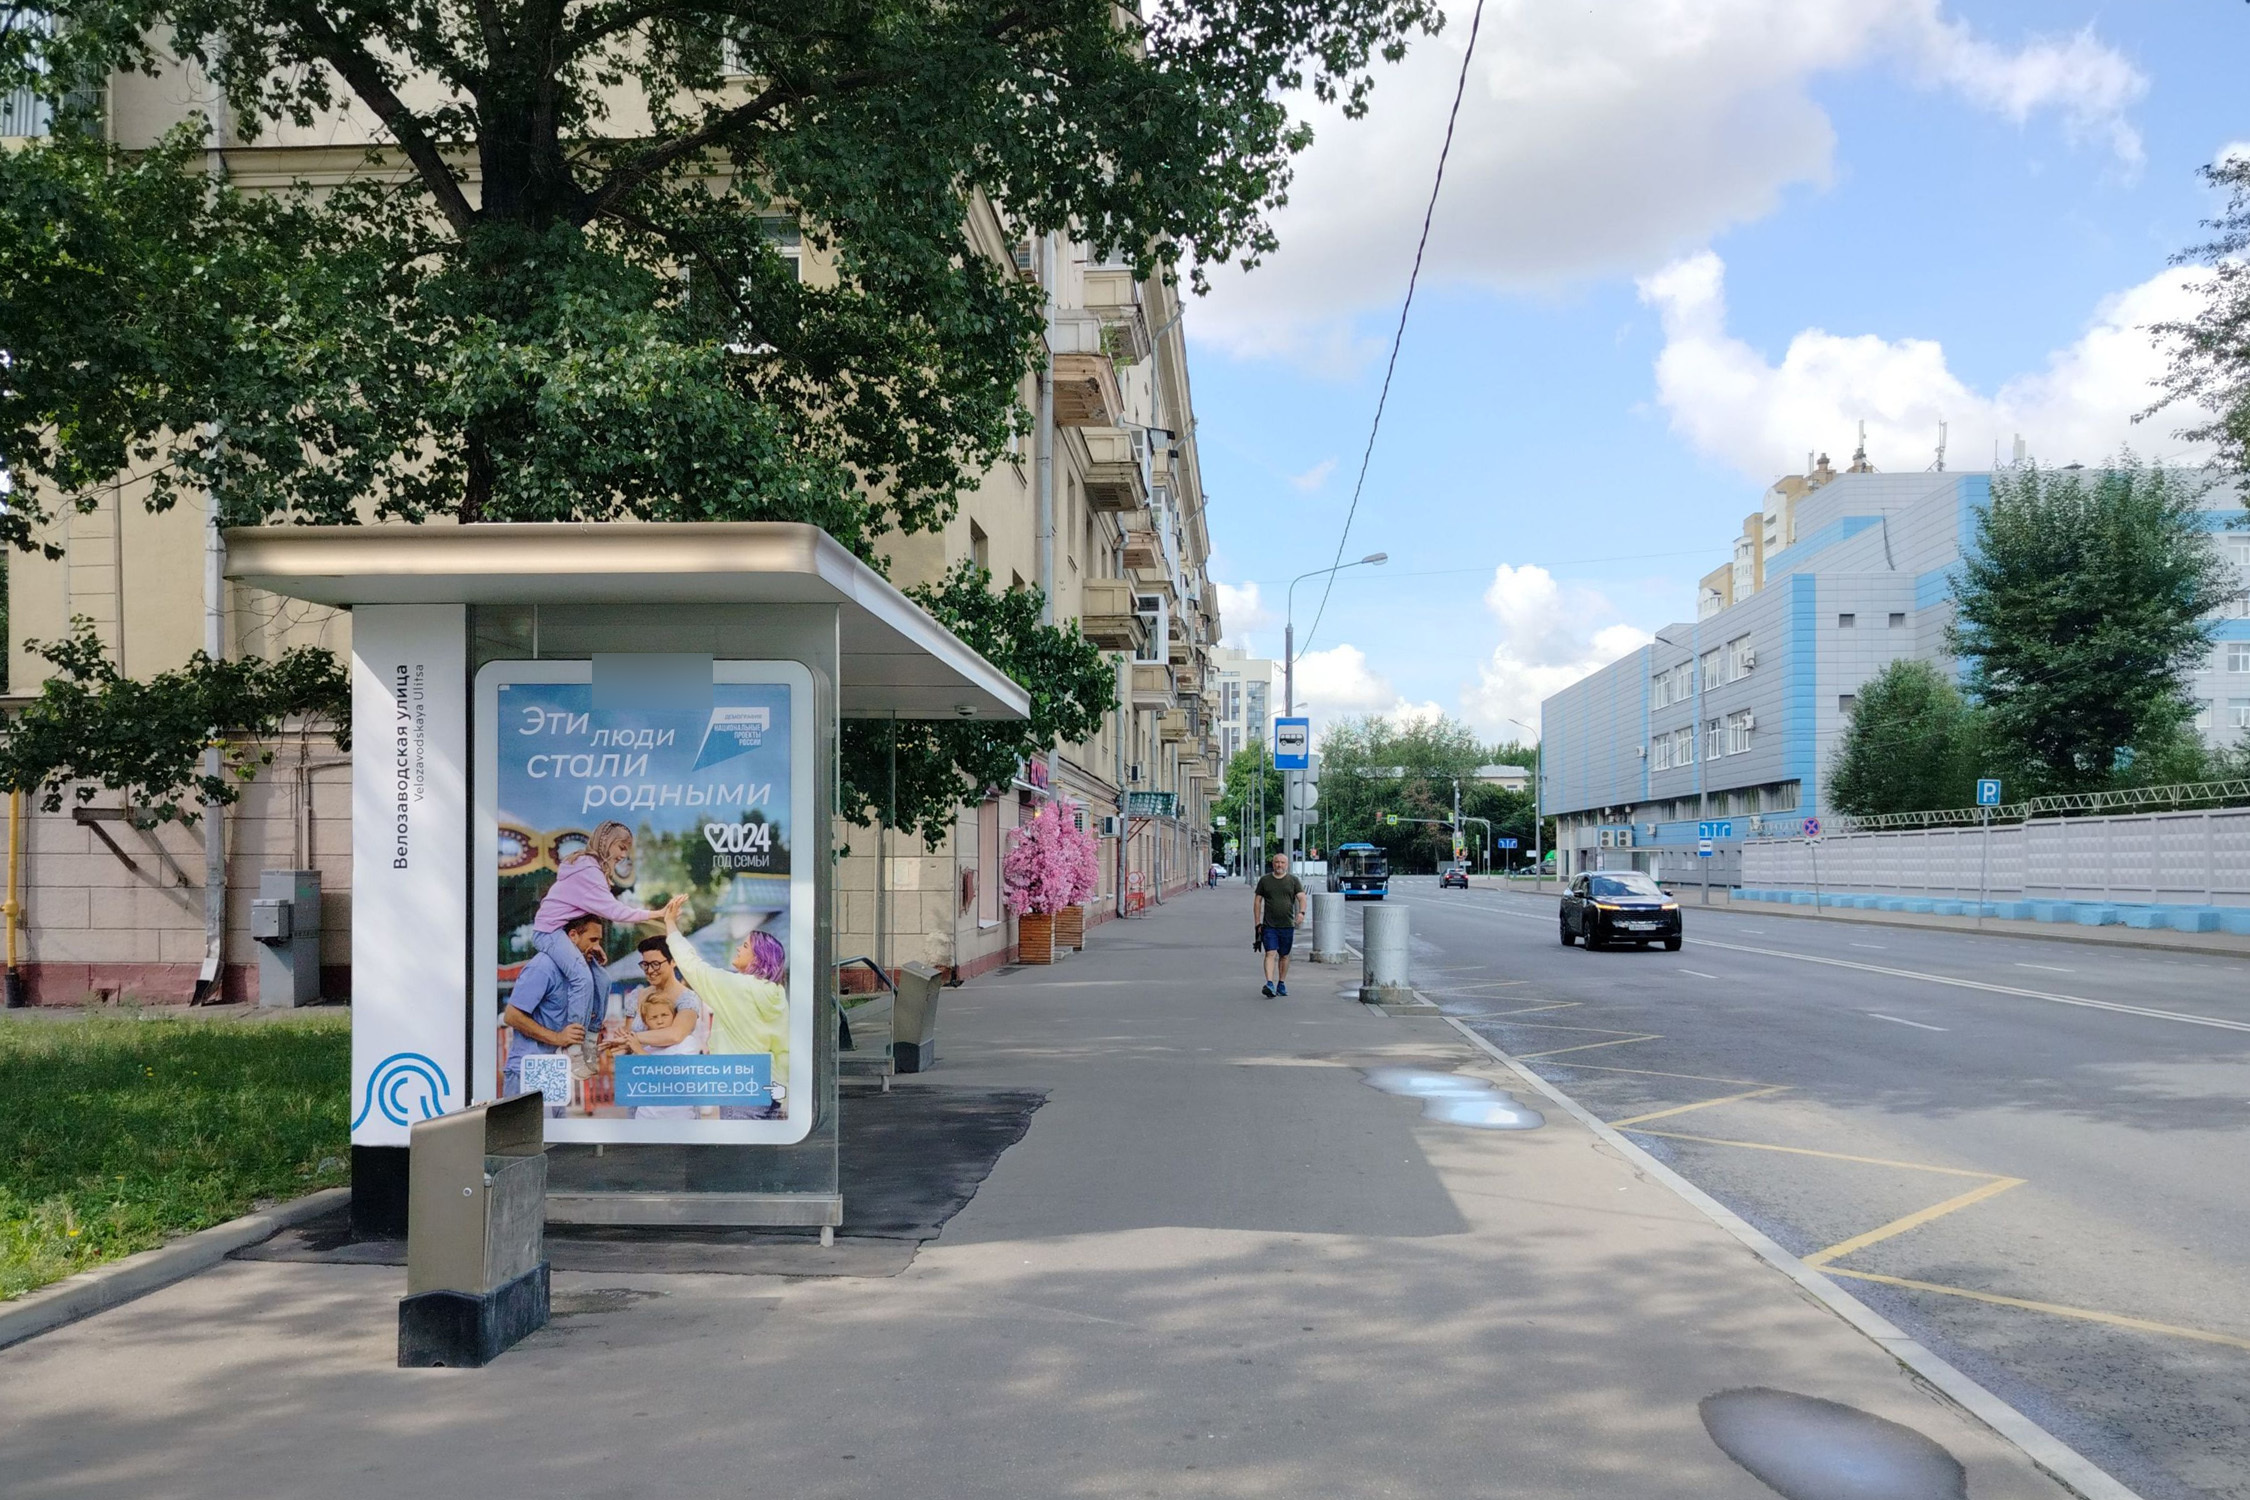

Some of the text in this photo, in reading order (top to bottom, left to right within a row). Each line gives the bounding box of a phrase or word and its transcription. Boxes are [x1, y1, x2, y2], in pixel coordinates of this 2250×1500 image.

[413, 664, 426, 802] Velozavodskaya Ulitsa
[518, 706, 675, 750] Эти люди
[714, 723, 762, 732] НАЦИОНАЛЬНЫЕ
[733, 731, 761, 739] ПРОЕКТЫ
[738, 738, 761, 747] РОССИИ
[393, 665, 411, 869] Велозаводская улица
[526, 753, 649, 779] стали
[581, 782, 771, 815] родными
[712, 822, 772, 853] 2024
[631, 1064, 754, 1075] СТАНОВИТЕСЬ И ВЫ
[626, 1077, 760, 1096] усыновите.рф
